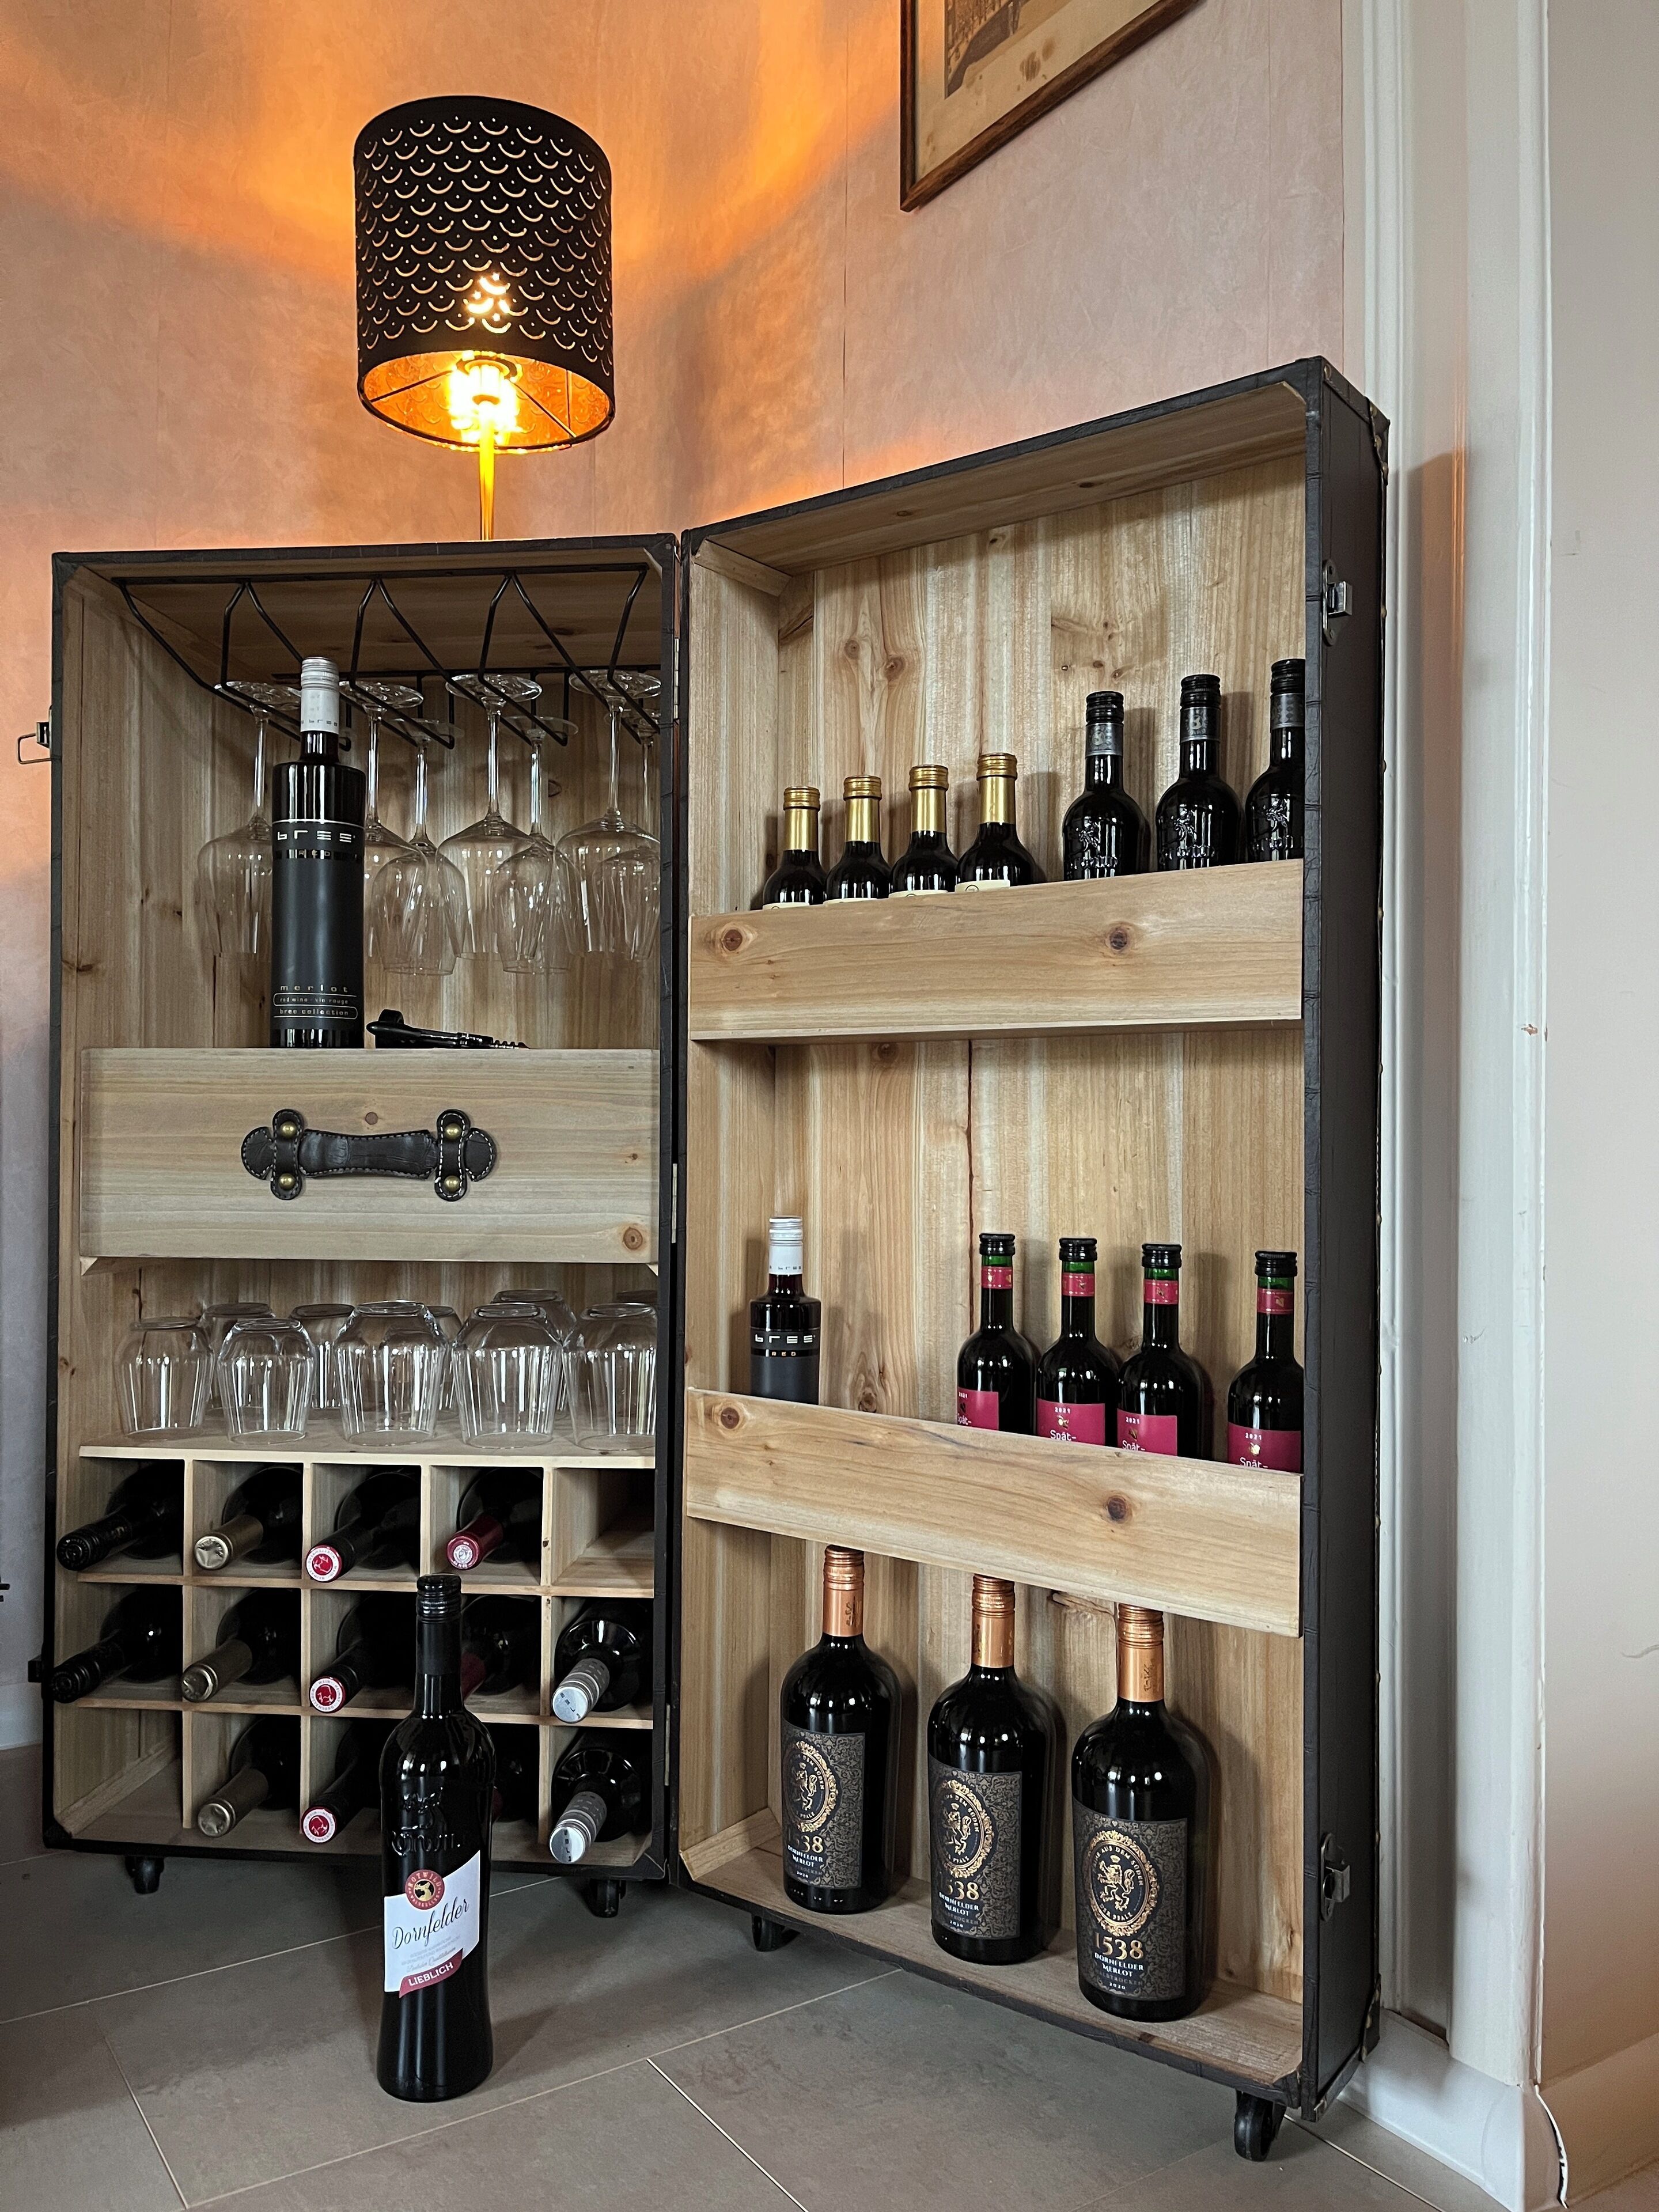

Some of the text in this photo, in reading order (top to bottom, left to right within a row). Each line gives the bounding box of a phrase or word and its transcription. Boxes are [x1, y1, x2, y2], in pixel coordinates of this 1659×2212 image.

[277, 830, 352, 843] bree
[280, 984, 348, 993] merlot
[755, 1334, 813, 1344] bree
[1245, 1432, 1262, 1440] 2021
[407, 1872, 442, 1888] ROTWILD
[392, 1896, 470, 1949] Dornfelder
[1094, 1931, 1144, 1960] 1538
[1094, 1952, 1145, 1971] DORNFELDER
[408, 1962, 454, 1986] LIEBLICH
[1101, 1963, 1134, 1977] MERLOT
